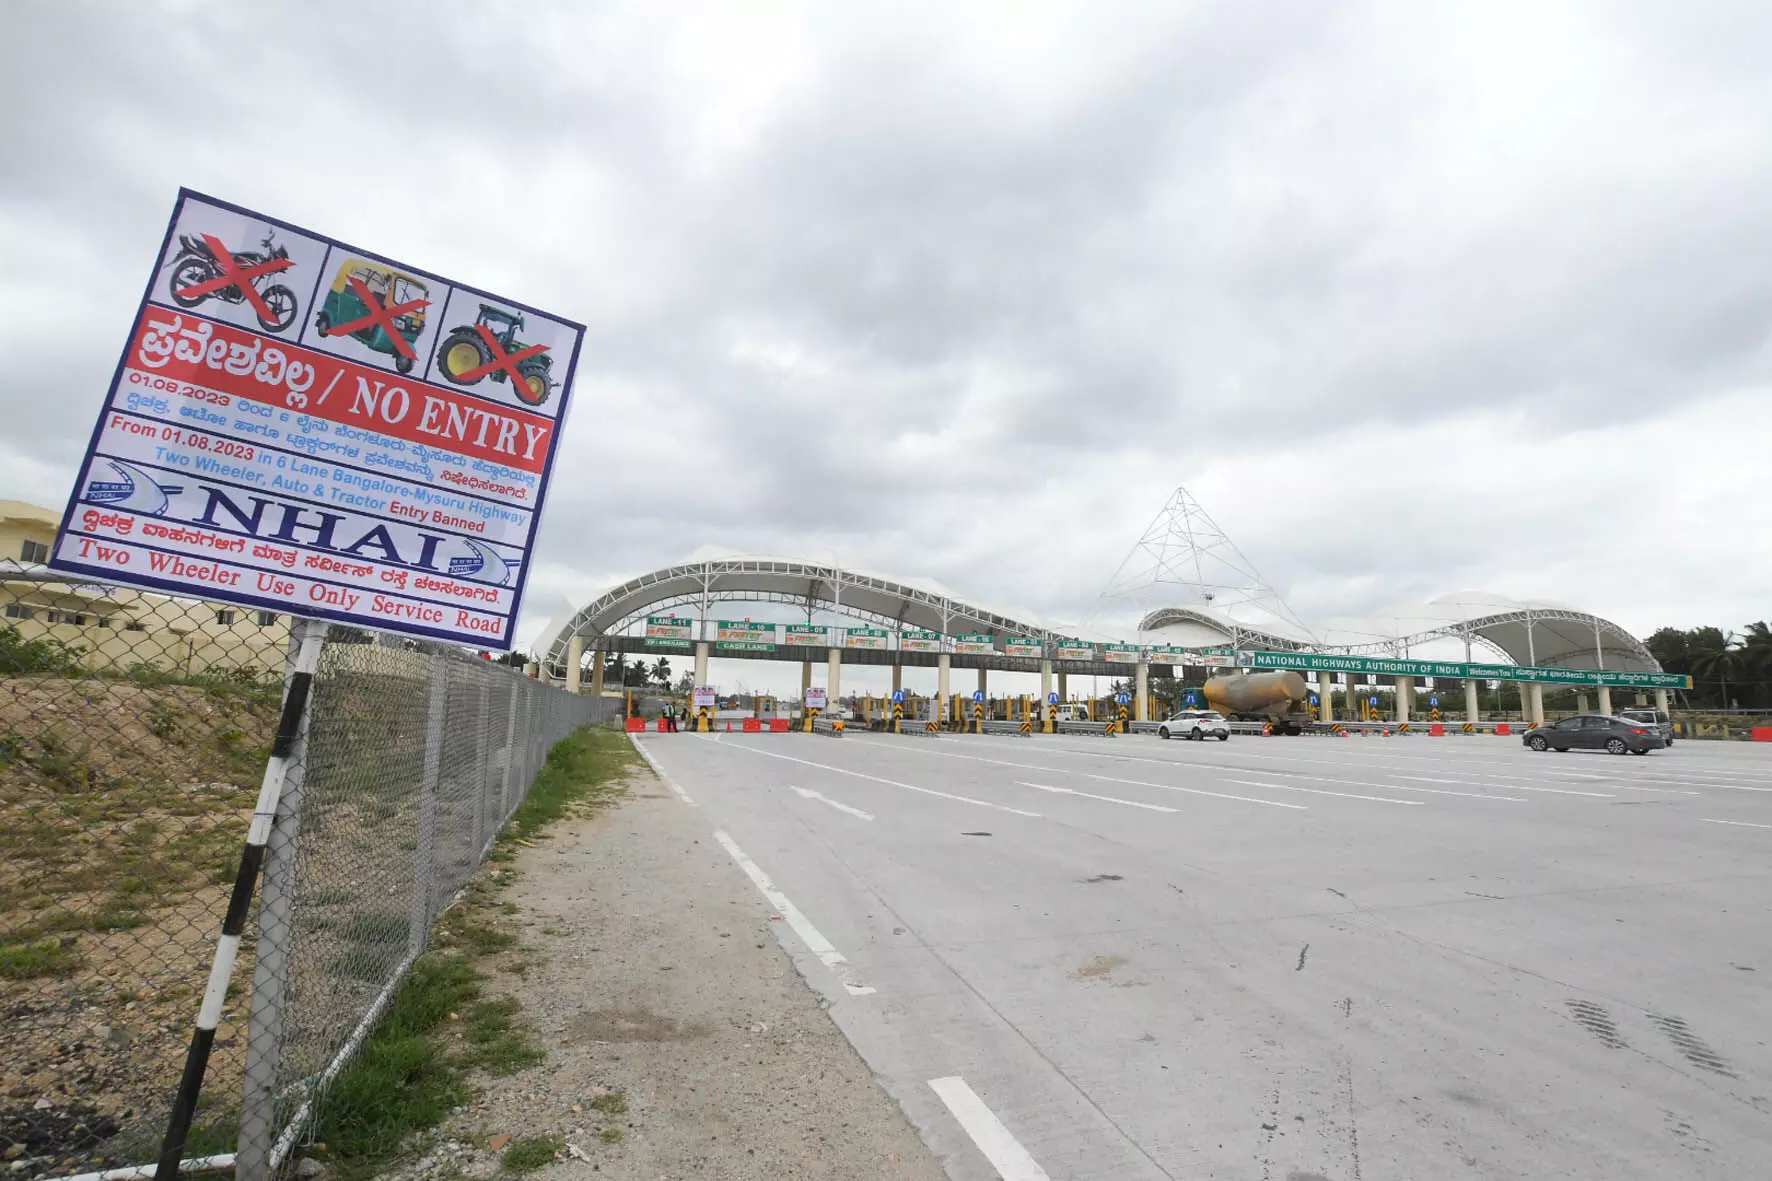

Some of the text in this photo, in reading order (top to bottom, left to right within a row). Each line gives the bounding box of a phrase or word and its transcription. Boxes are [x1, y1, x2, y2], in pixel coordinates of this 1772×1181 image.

[129, 372, 231, 407] 01.08.2023
[237, 399, 273, 418] ರಿಂದ
[138, 315, 315, 409] ಪ್ರವೇಶವಿಲ್ಲ
[348, 376, 410, 424] NO
[416, 395, 548, 461] ENTRY
[234, 418, 280, 440] ಹಾಗೂ
[110, 415, 527, 526] From 01.08.2023 in 6 Lane Bangalore-Mysuru Highway
[155, 446, 486, 532] Two Wheeler, Auto & Tractor Entry Banned
[83, 509, 135, 535] ದ್ವಿಚಕ್ರ
[142, 522, 246, 553] ವಾಹನಗಳಿಗೆ
[252, 543, 298, 568] ಮಾತ್ರ
[380, 568, 409, 590] ರಸ್ತೆ
[192, 485, 447, 570] NHAI
[78, 537, 502, 634] Two Wheeler Use Only Service Road
[1257, 655, 1460, 675] NATIONAL HIGHWAYS AUTHORITY OF INDIA
[1468, 667, 1511, 677] Welcomes You
